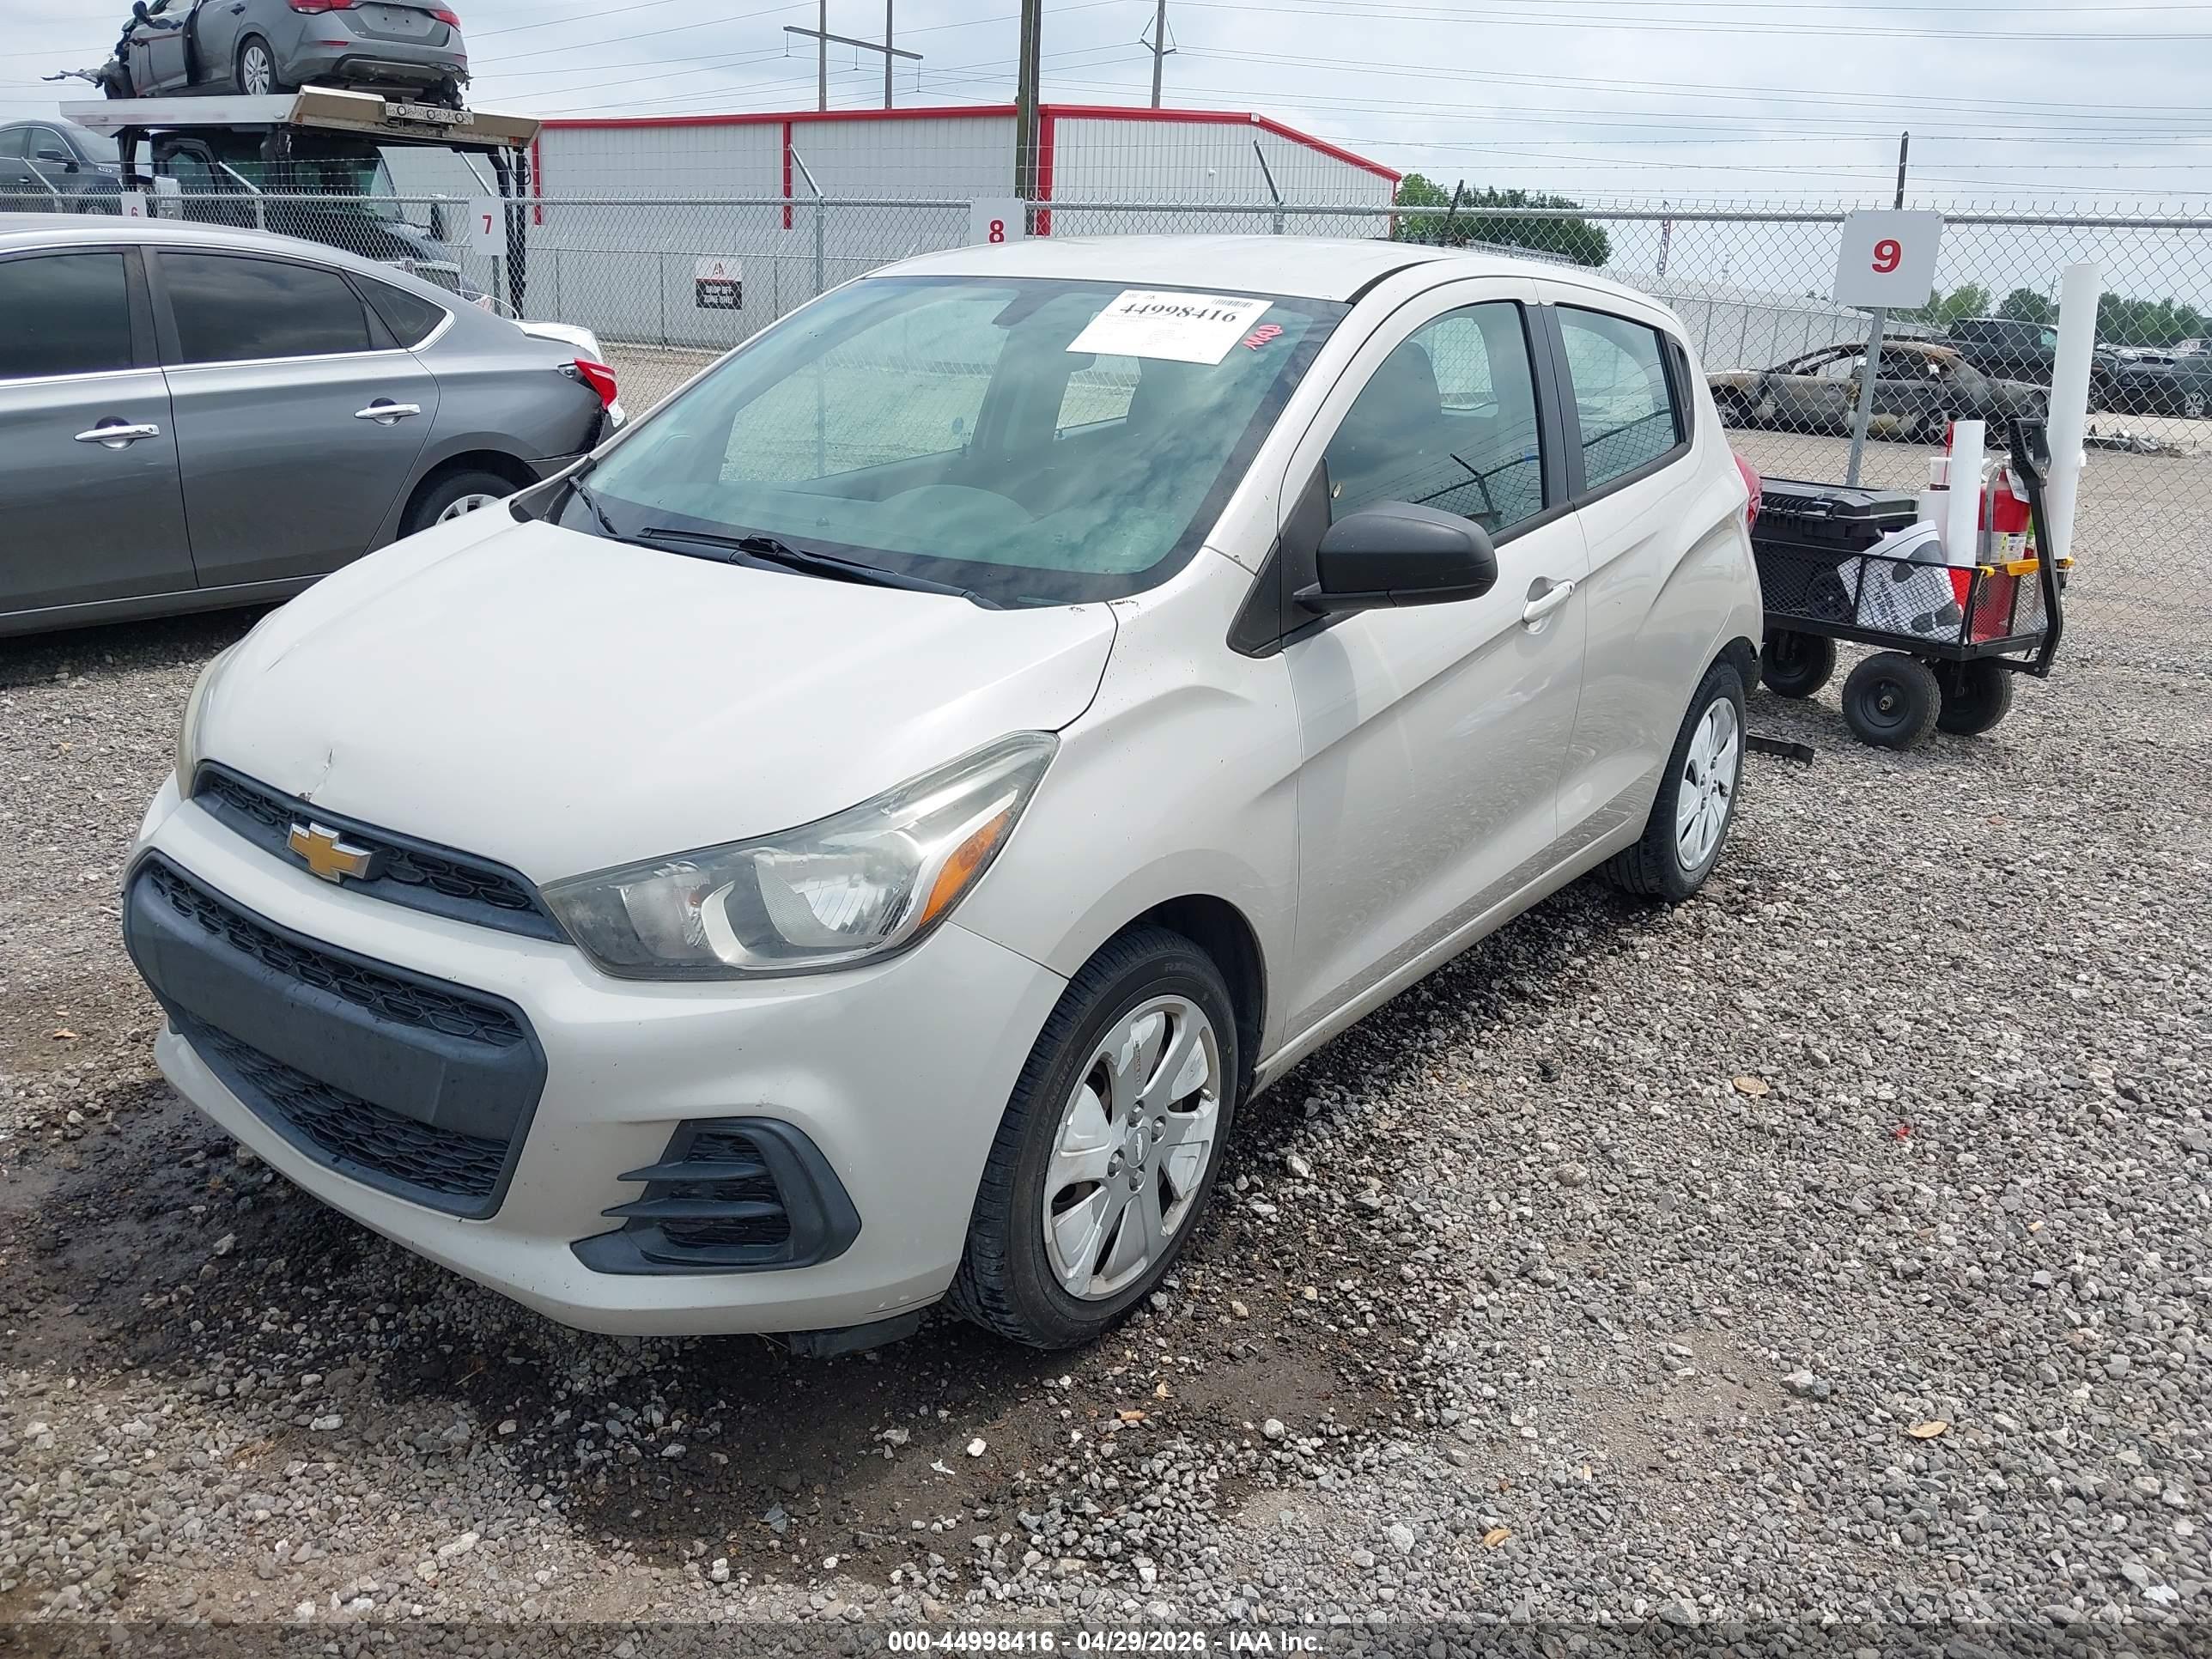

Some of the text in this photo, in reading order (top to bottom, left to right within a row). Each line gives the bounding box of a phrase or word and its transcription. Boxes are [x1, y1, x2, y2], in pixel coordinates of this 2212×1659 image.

[482, 215, 492, 234] 7
[989, 220, 1005, 243] 8
[1872, 239, 1901, 273] 9
[720, 295, 733, 304] ONLY
[1119, 302, 1237, 324] 44998416
